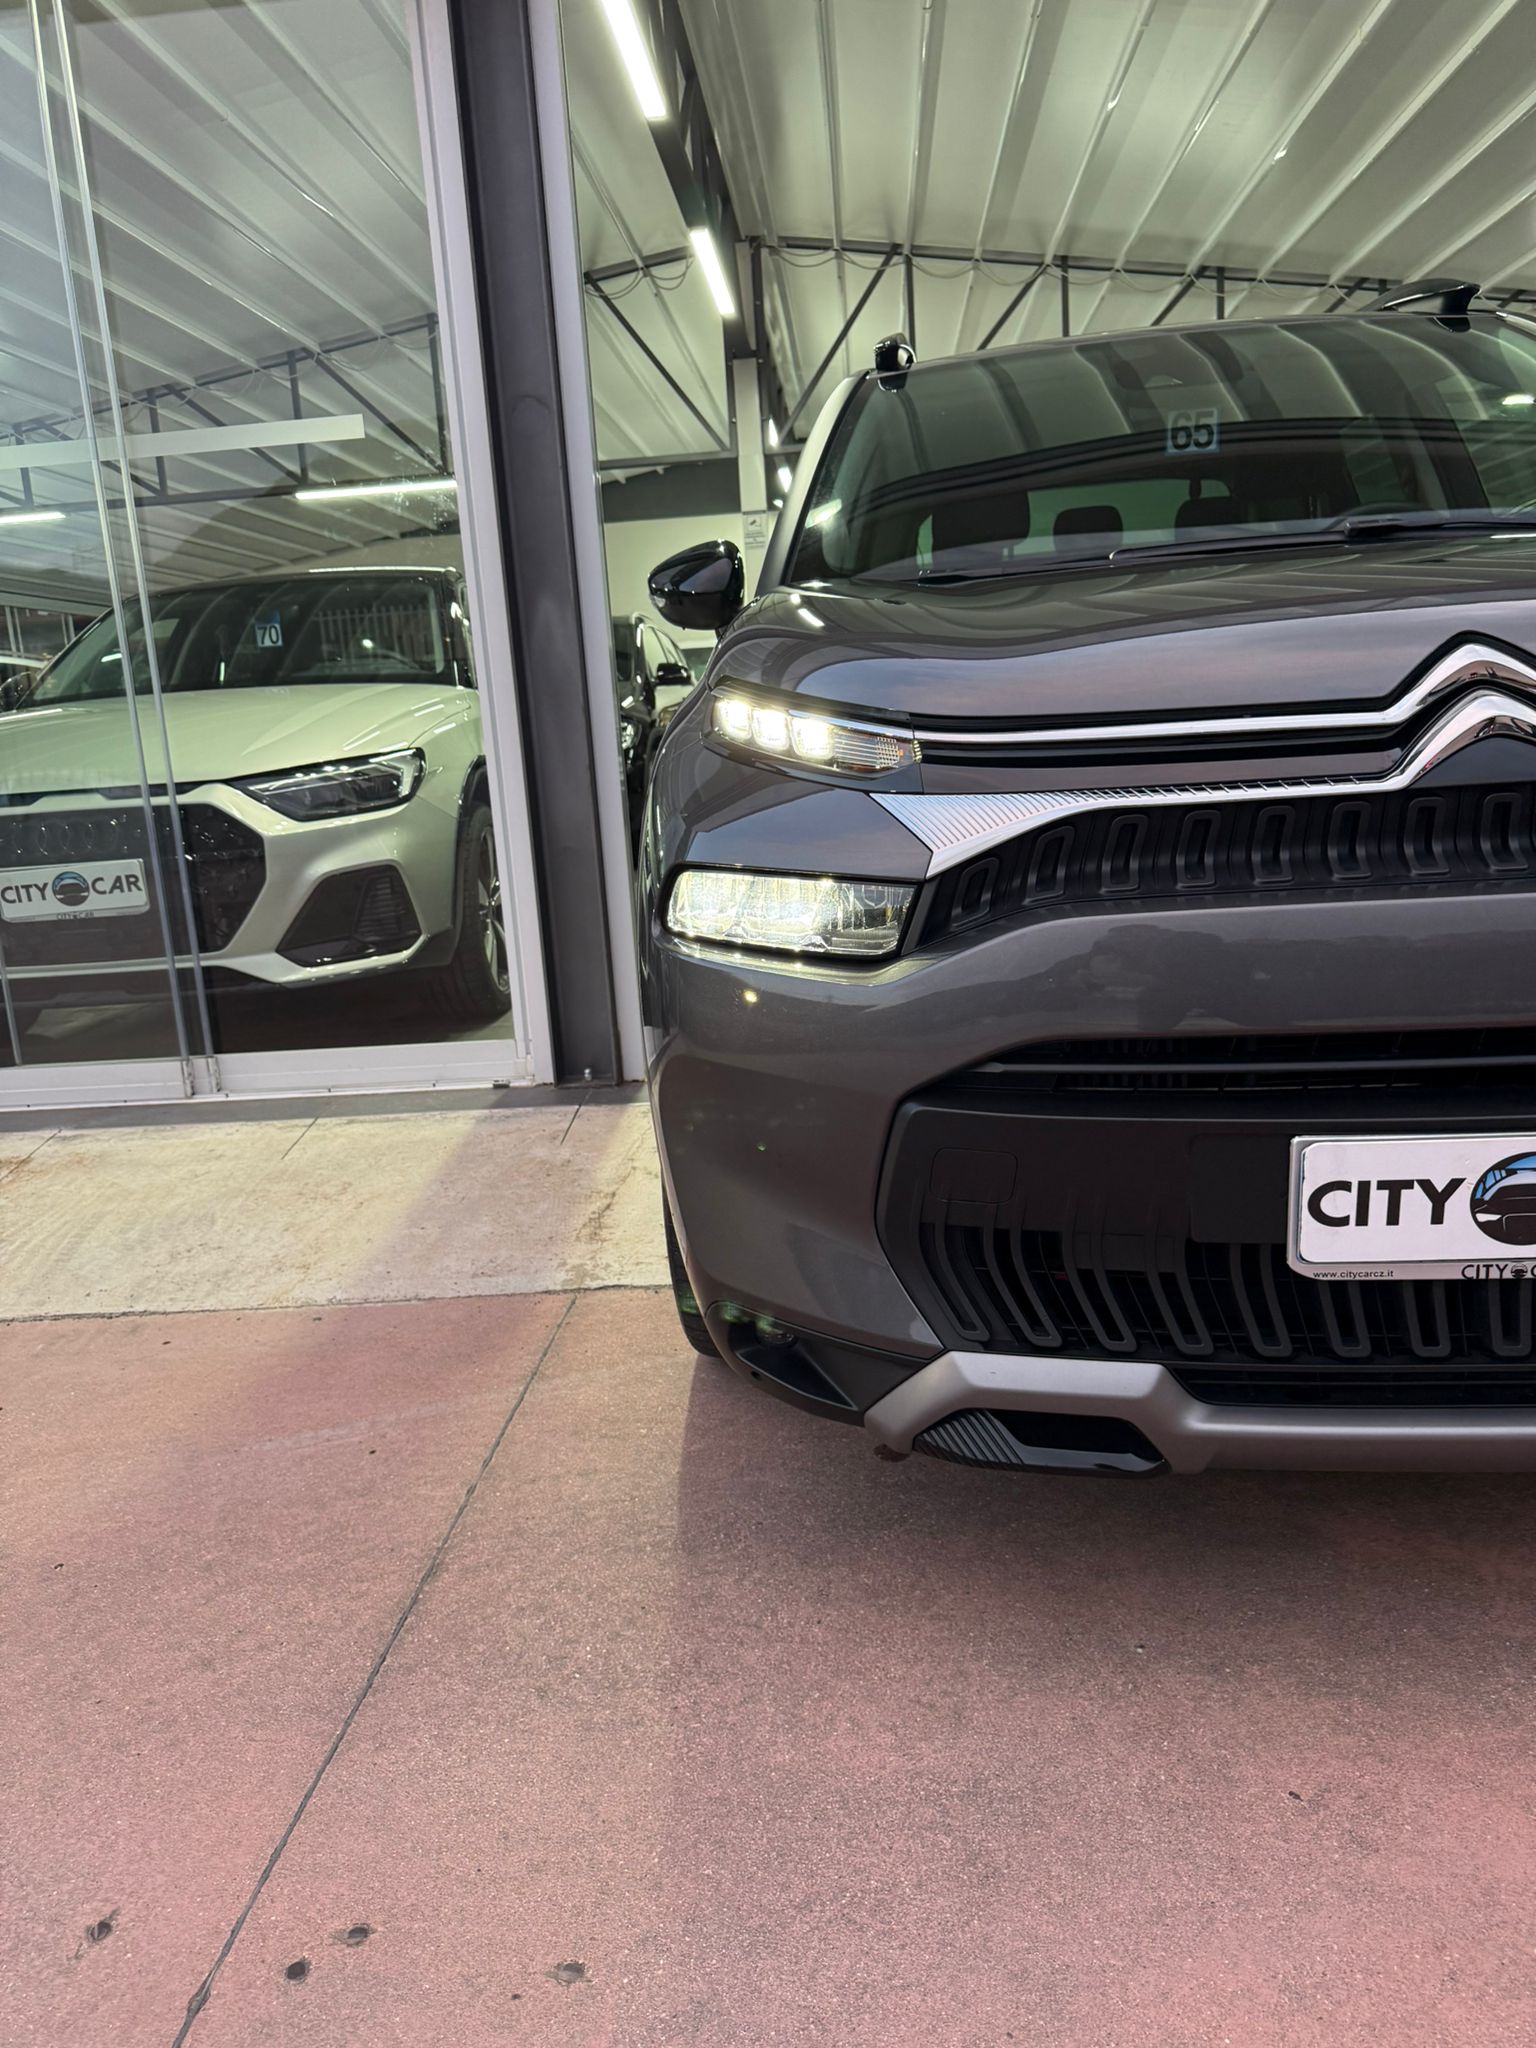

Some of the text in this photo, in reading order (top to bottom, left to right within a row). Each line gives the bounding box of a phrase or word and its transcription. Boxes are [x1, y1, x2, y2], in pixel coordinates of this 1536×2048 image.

[1171, 411, 1214, 451] 65
[257, 624, 279, 645] 70
[0, 874, 143, 904] CITY CAR
[1307, 1178, 1467, 1227] CITY
[1313, 1269, 1394, 1279] www.citycarcz.it
[1461, 1263, 1508, 1280] CITY
